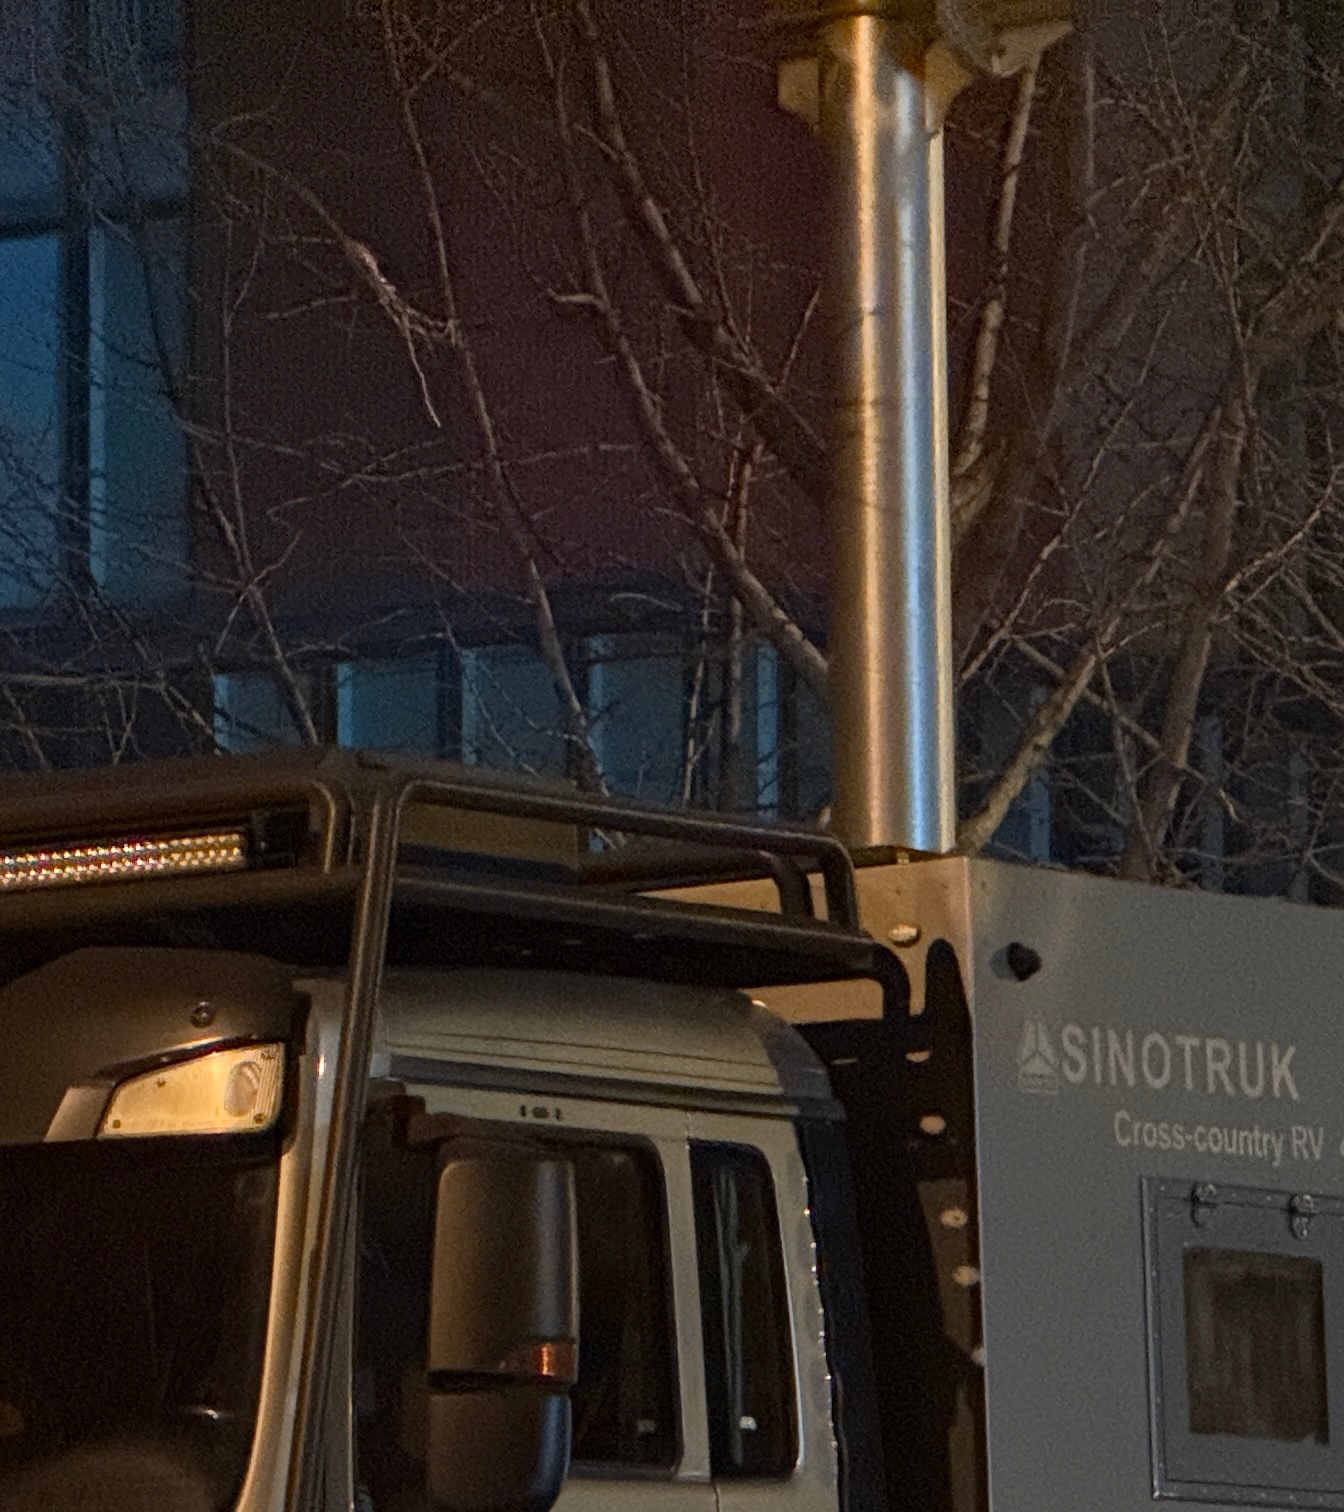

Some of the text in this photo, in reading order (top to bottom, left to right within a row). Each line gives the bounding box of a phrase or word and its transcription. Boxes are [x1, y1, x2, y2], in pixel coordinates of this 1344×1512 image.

[1062, 1023, 1301, 1101] SINOTRUK
[1114, 1110, 1284, 1168] Cross-country
[1291, 1126, 1324, 1161] RV
